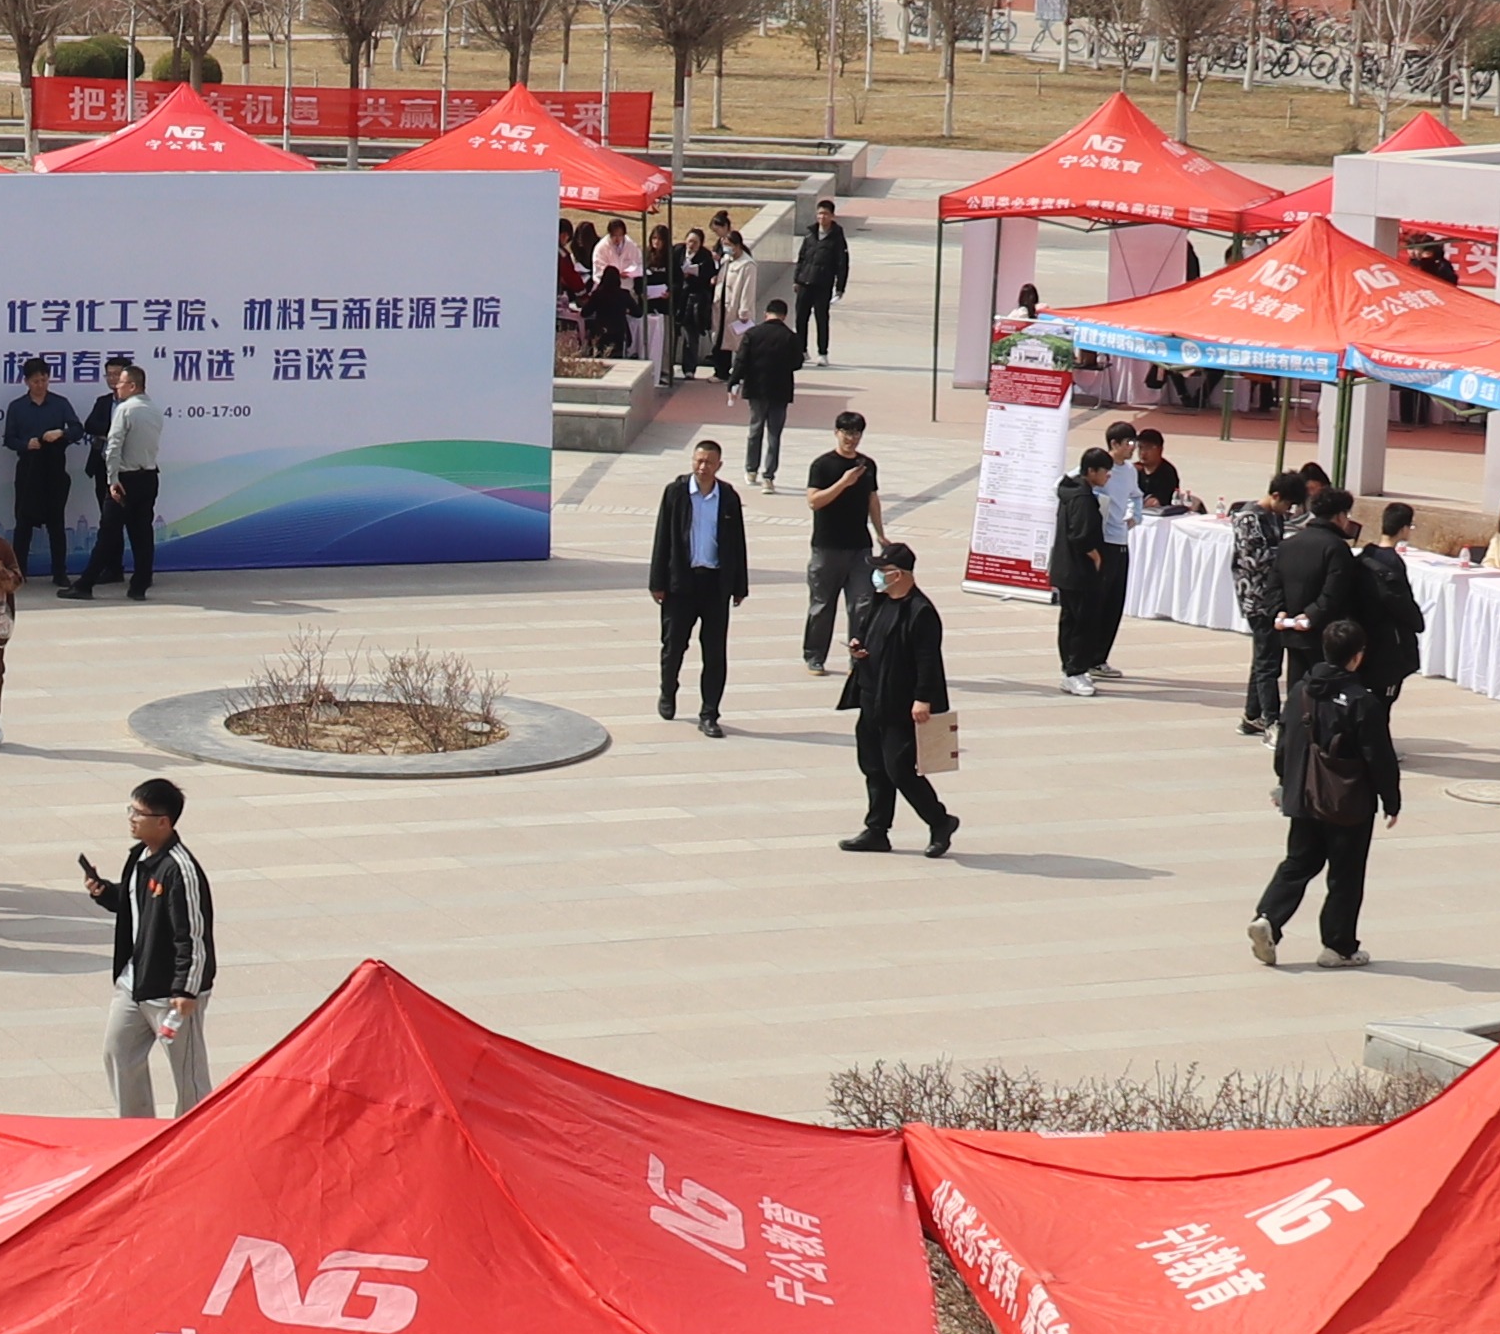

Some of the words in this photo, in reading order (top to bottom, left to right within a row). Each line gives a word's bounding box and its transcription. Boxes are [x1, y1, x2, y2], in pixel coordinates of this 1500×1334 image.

[358, 96, 606, 135] 共赢美未来
[165, 124, 206, 139] NG
[492, 122, 536, 138] NG
[1083, 134, 1125, 153] NG
[1249, 259, 1308, 291] NG
[1211, 286, 1306, 324] 宁公教育
